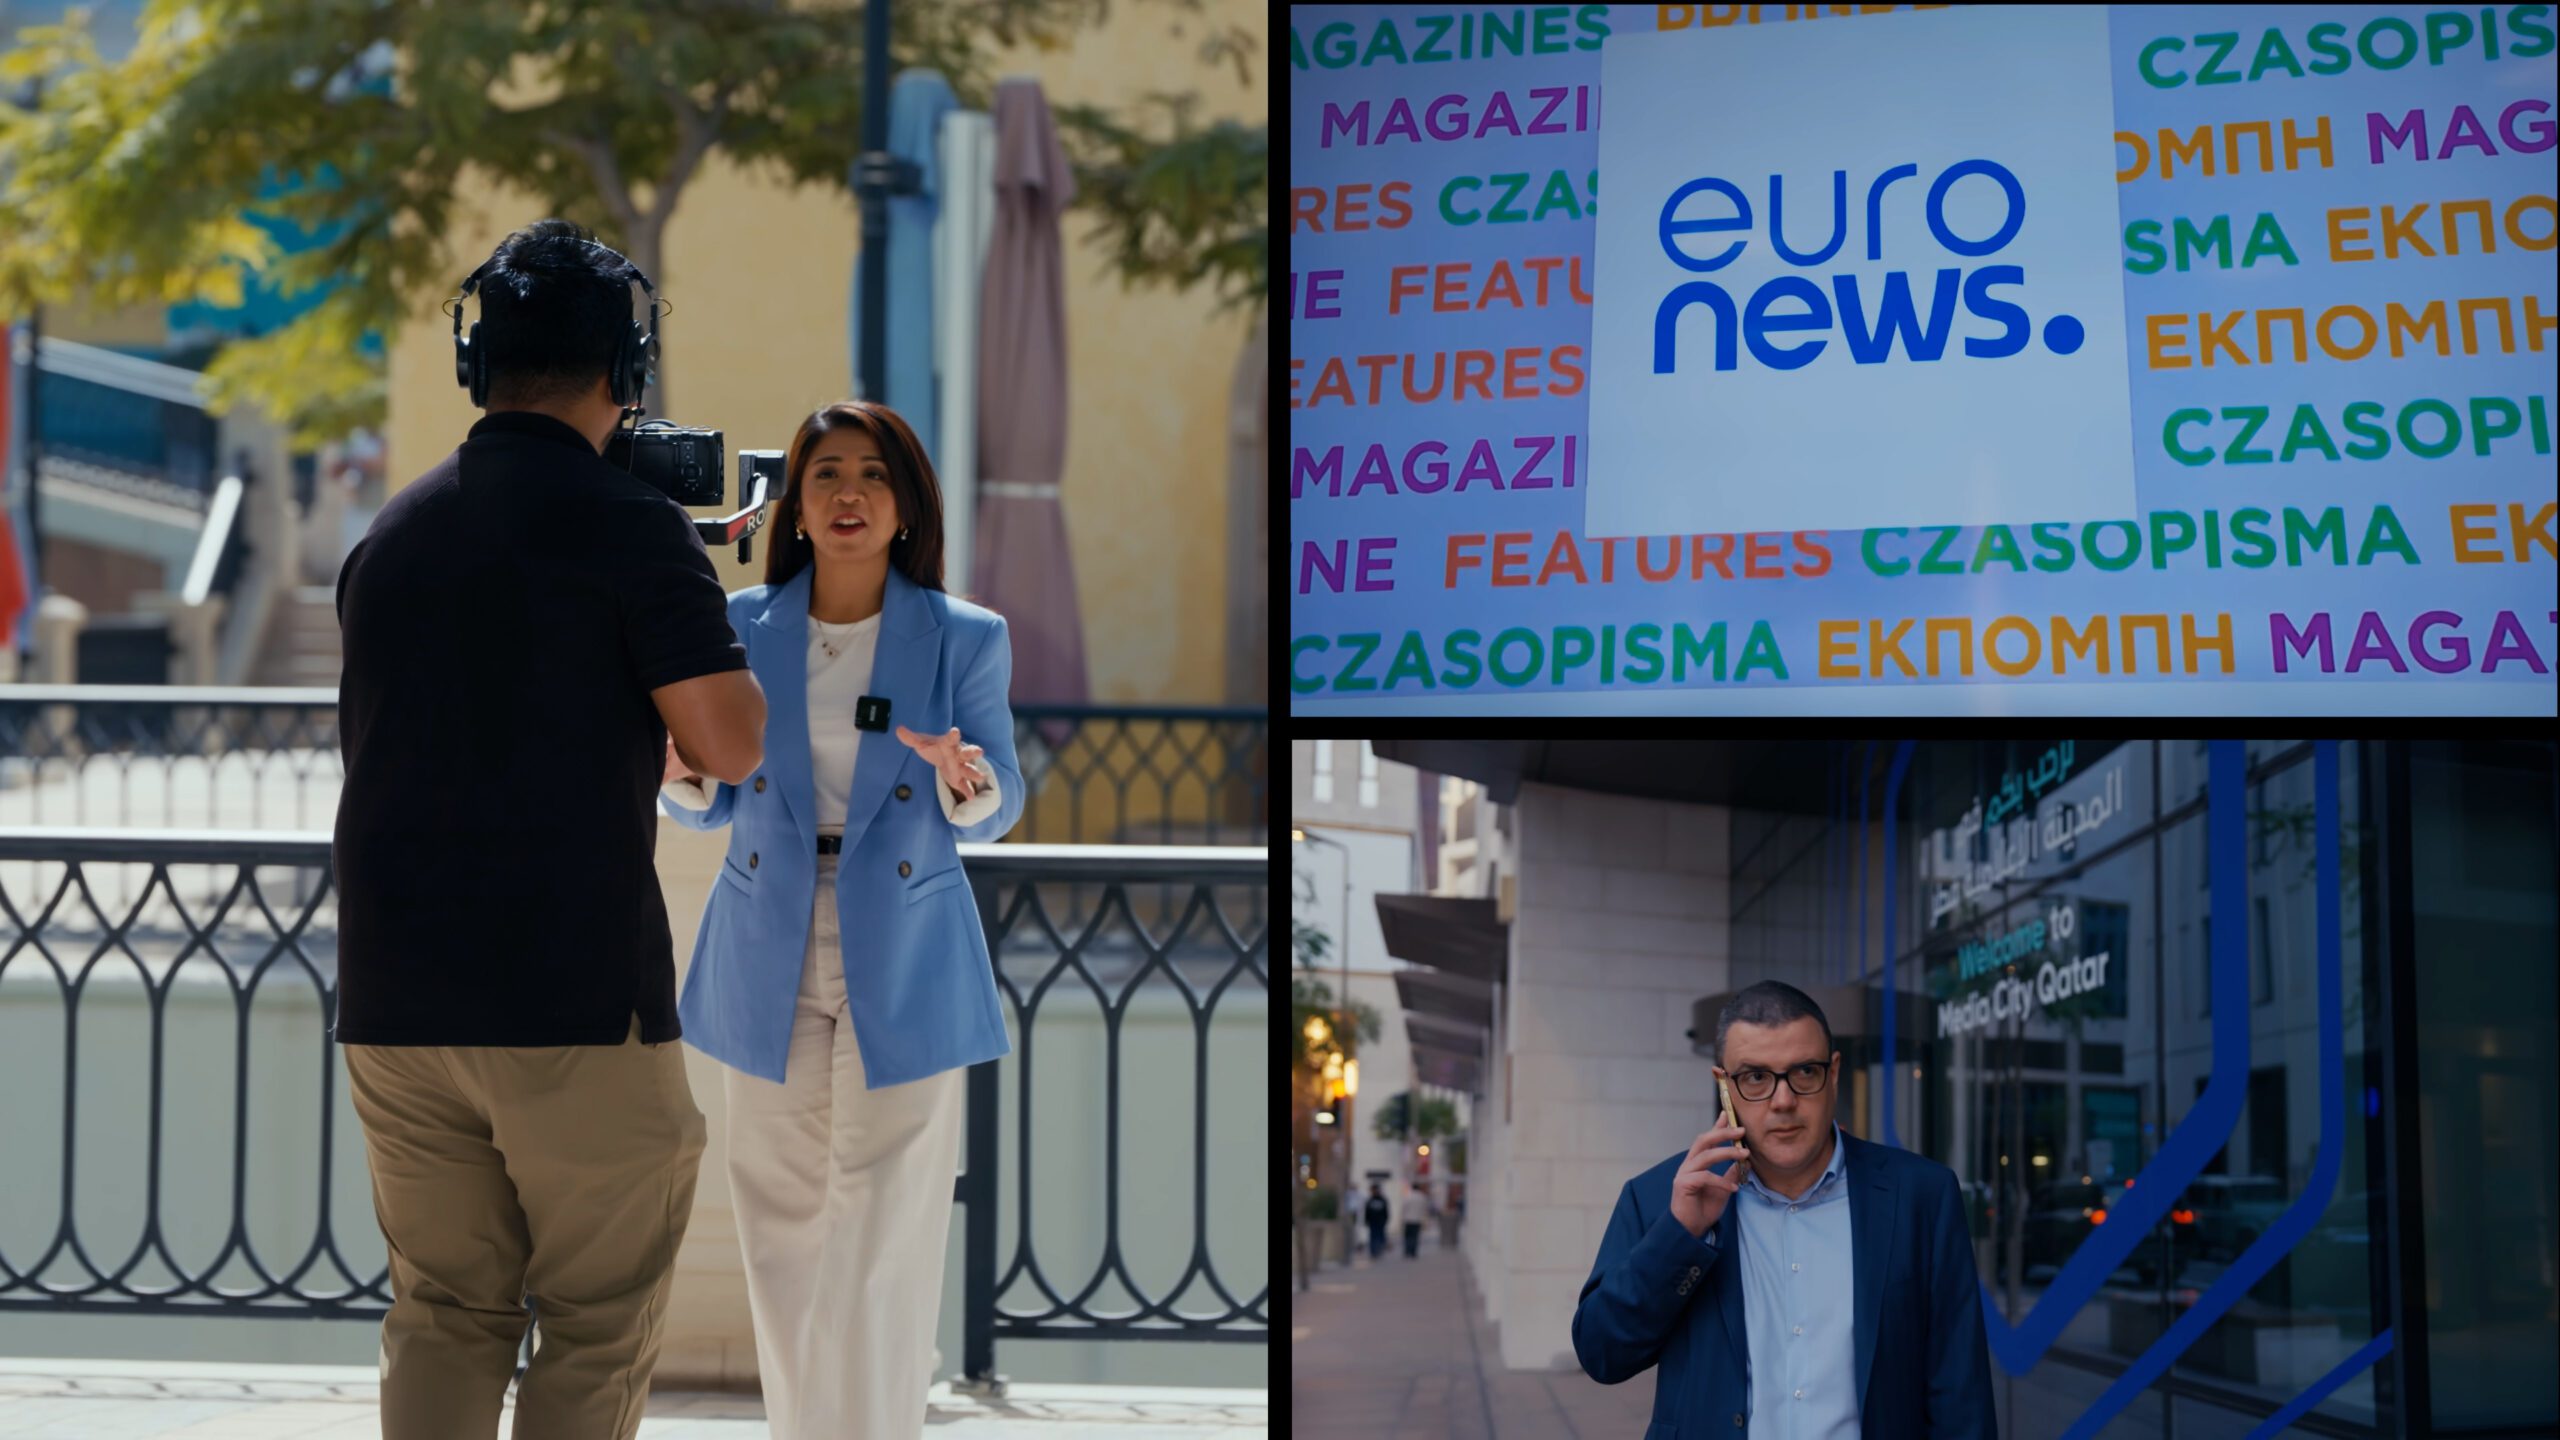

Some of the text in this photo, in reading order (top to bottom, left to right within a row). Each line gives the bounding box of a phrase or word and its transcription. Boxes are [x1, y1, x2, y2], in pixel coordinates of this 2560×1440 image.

[2138, 5, 2556, 89] CZASOPIS
[1320, 85, 1601, 148] MAGAZI
[2366, 99, 2557, 164] MAG
[1291, 181, 1413, 234] RES
[1659, 159, 2026, 272] euro
[2124, 213, 2299, 275] SMA
[1653, 265, 2085, 374] news.
[2163, 395, 2551, 466] CZASOPI
[1445, 531, 1833, 588] FEATURES
[1861, 505, 2421, 577] CZASOPISMA
[1291, 619, 1789, 693] CZASOPISMA
[2269, 611, 2557, 673] MAGA
[1958, 905, 2075, 980] Welcome to
[1938, 952, 2109, 1038] Media City Qatar
